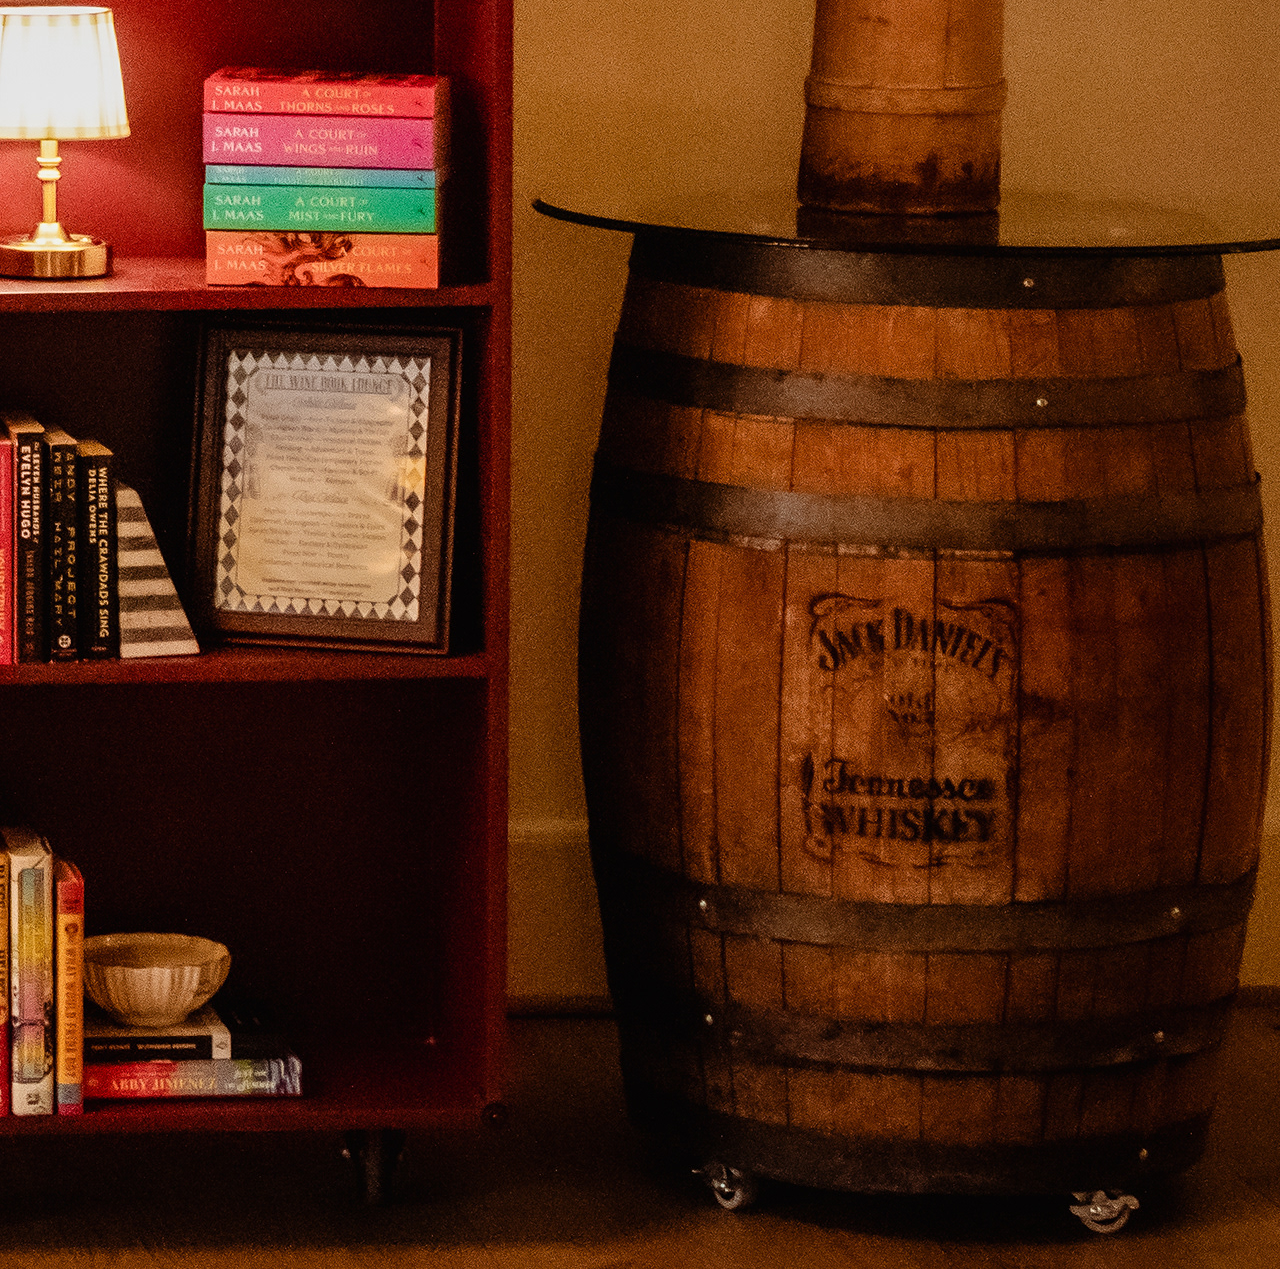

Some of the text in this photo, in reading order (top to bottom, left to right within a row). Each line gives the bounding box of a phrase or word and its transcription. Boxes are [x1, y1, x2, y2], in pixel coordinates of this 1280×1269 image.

[215, 85, 260, 97] SARAH
[314, 87, 360, 99] COURT
[224, 100, 263, 112] MAAS
[279, 101, 333, 113] THORNS
[351, 103, 395, 115] ROSES
[215, 126, 260, 138] SARAH
[308, 129, 354, 141] COURT
[223, 141, 263, 153] MAAS
[282, 143, 327, 155] WINGS
[346, 144, 378, 156] RUIN
[215, 195, 262, 206] SARAH
[310, 196, 357, 208] COURT
[225, 210, 265, 221] MAAS
[289, 211, 320, 221] MIST
[341, 211, 375, 222] FURY
[217, 244, 264, 256] SARAH
[226, 259, 267, 272] MAAS
[311, 262, 412, 274] SILVER FLAMES
[32, 453, 41, 484] SEVEN
[53, 452, 63, 503] WEIR
[65, 452, 76, 502] ANDY
[20, 445, 32, 540] EVELYN HUGO
[98, 466, 109, 509] WHERE
[32, 486, 41, 536] HUSBANDS
[87, 468, 98, 545] DELIA OWENS
[98, 512, 109, 536] THE
[53, 521, 63, 569] HAIL
[66, 526, 77, 620] PROJECT
[98, 538, 110, 607] CRAWDADS
[98, 608, 110, 639] SING
[818, 618, 884, 672] JACK
[823, 757, 996, 802] Tennessee
[820, 804, 993, 845] WHISKEY
[111, 1078, 216, 1091] ABBY JIMENEZ
